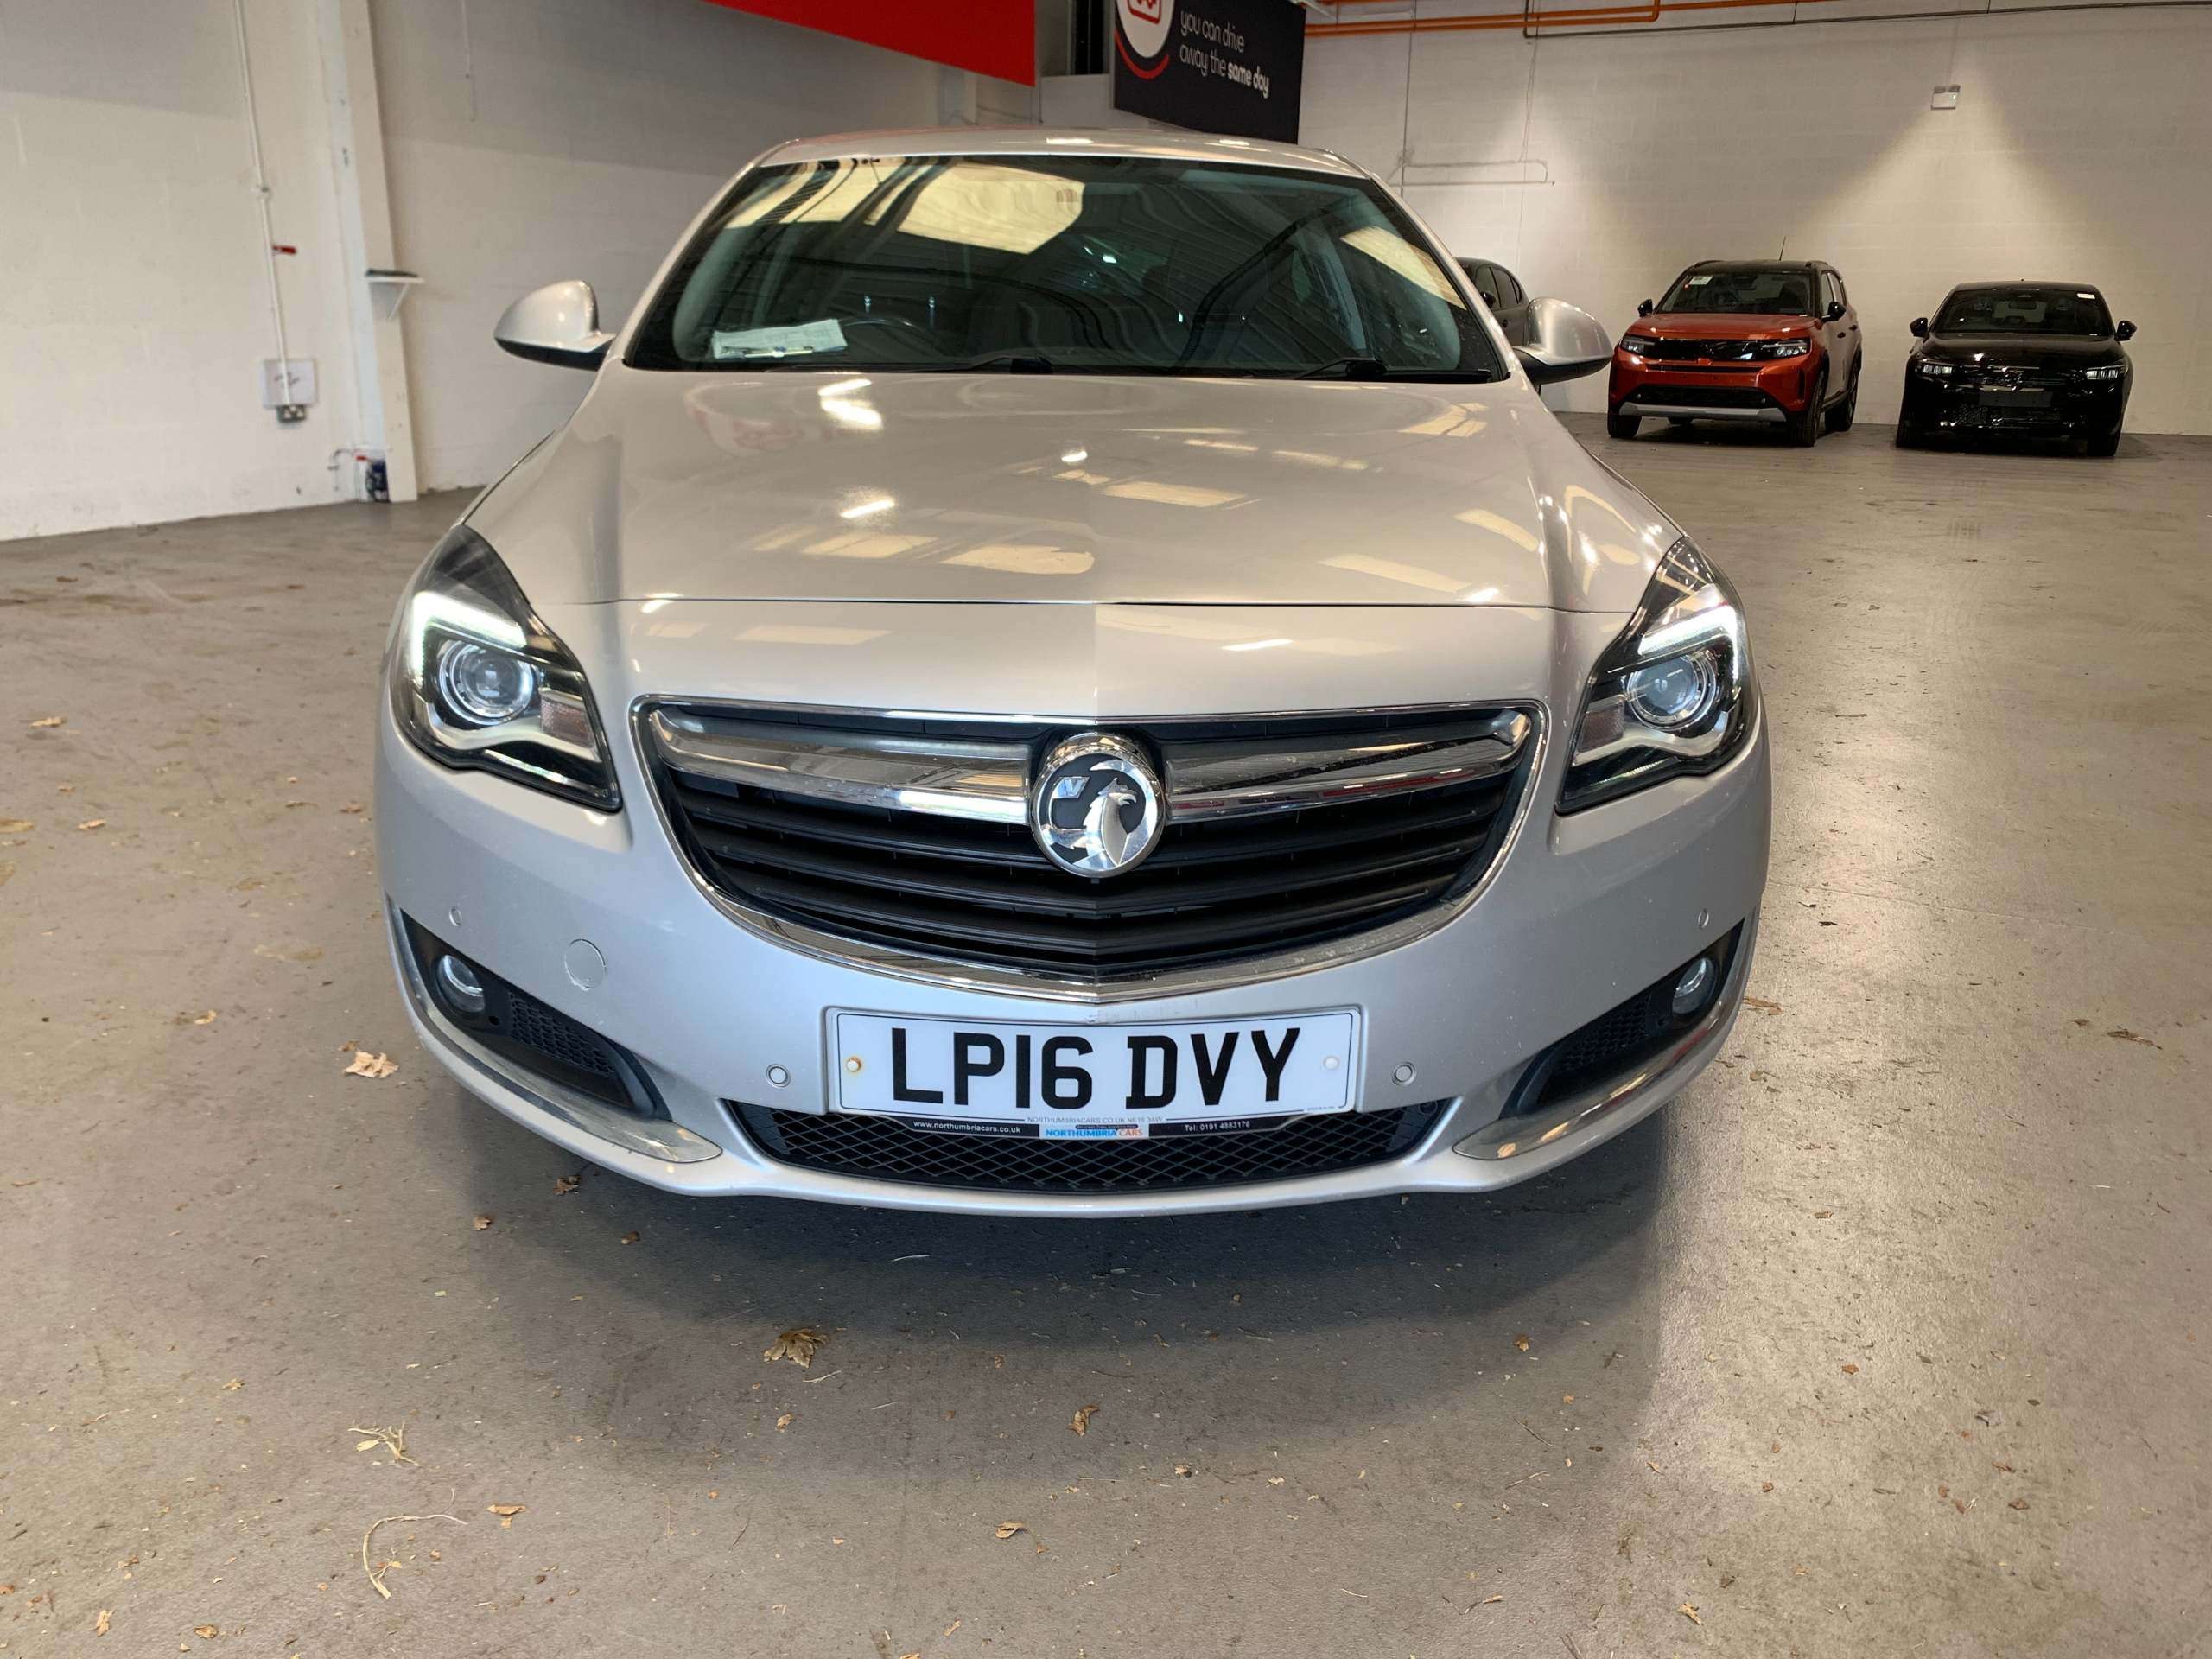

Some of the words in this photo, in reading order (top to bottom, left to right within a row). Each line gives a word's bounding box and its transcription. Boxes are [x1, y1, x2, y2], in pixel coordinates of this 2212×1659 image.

[1180, 10, 1199, 36] you
[1202, 20, 1221, 43] can
[1222, 22, 1245, 54] drive
[1179, 44, 1210, 77] away
[1210, 49, 1227, 79] the
[1228, 61, 1252, 86] same
[1253, 66, 1270, 99] day
[891, 1027, 1093, 1109] LP16
[1125, 1027, 1301, 1110] DVY
[912, 1121, 1021, 1134] www.northumbriacars.co.uk
[1046, 1128, 1116, 1137] NORTHUMBRIA
[1118, 1128, 1143, 1137] CARS
[1185, 1123, 1198, 1132] Tel:
